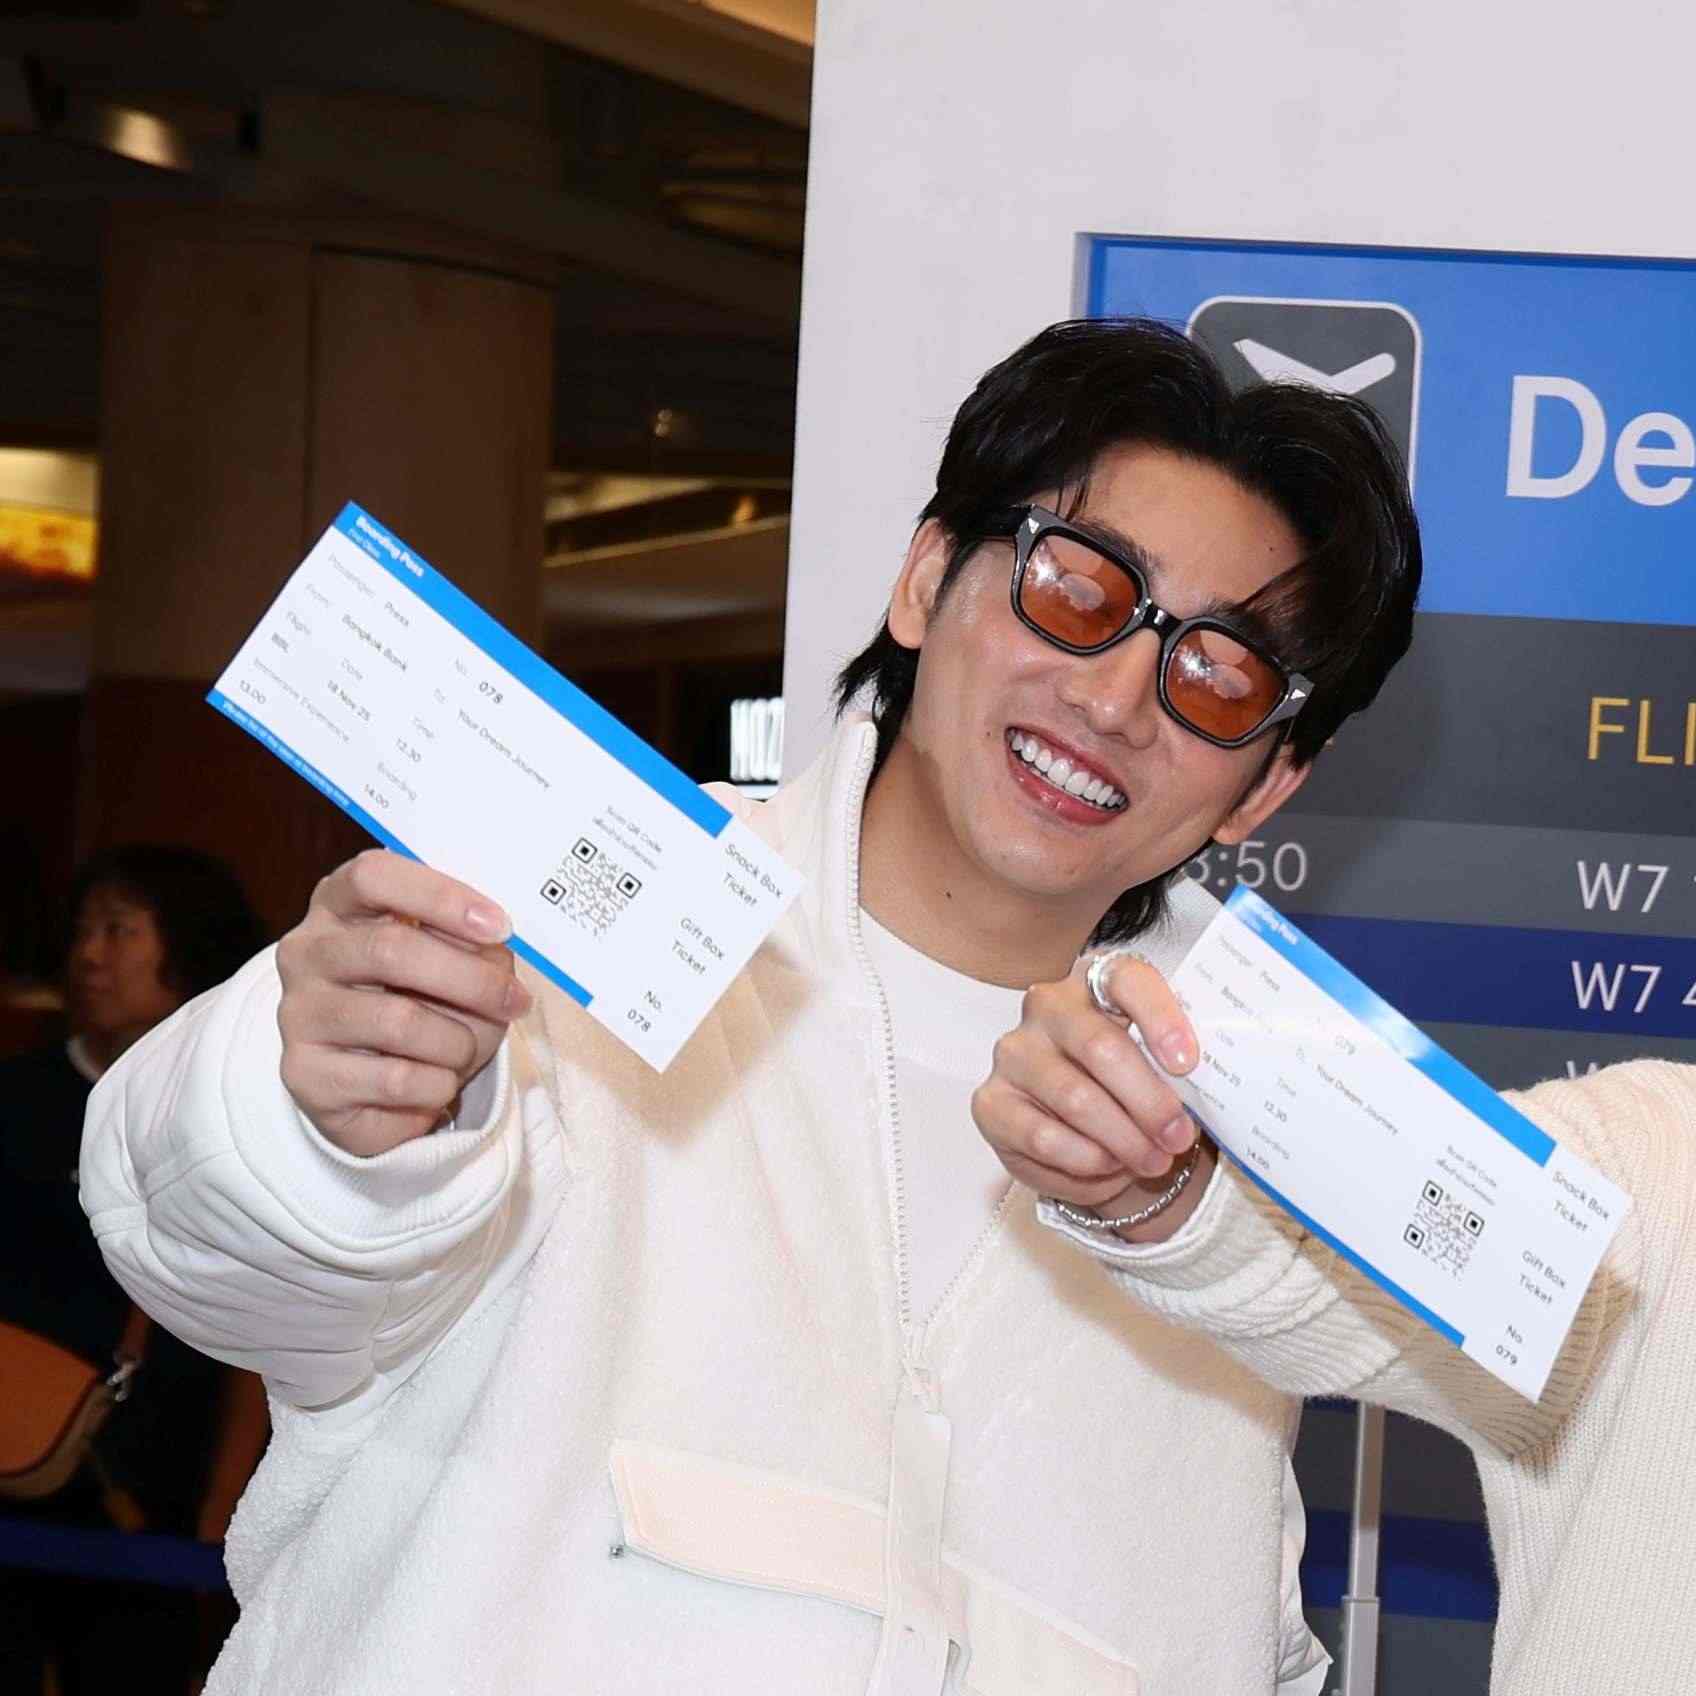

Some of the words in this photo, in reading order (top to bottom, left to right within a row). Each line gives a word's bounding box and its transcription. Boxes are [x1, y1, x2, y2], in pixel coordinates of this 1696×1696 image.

[352, 513, 403, 560] Boarding
[397, 550, 427, 578] Pass
[339, 612, 385, 653] Bangkok
[382, 647, 409, 673] Bank
[476, 679, 504, 705] 078
[477, 726, 513, 759] Dream
[510, 753, 552, 791] Journey
[720, 871, 760, 908] Ticket
[722, 841, 762, 879] Snack
[758, 872, 786, 899] Box
[1577, 860, 1669, 913] W7
[669, 939, 708, 976] Ticket
[677, 915, 705, 942] Gift
[700, 934, 727, 961] Box
[1571, 960, 1662, 1013] W7
[625, 1006, 653, 1033] 078
[1550, 1168, 1586, 1205] Snack
[1586, 1196, 1611, 1222] Box
[1551, 1198, 1589, 1235] Ticket
[1516, 1270, 1553, 1309] Ticket
[1520, 1246, 1544, 1274] Gift
[1542, 1265, 1567, 1292] Box
[1493, 1340, 1519, 1370] 079
